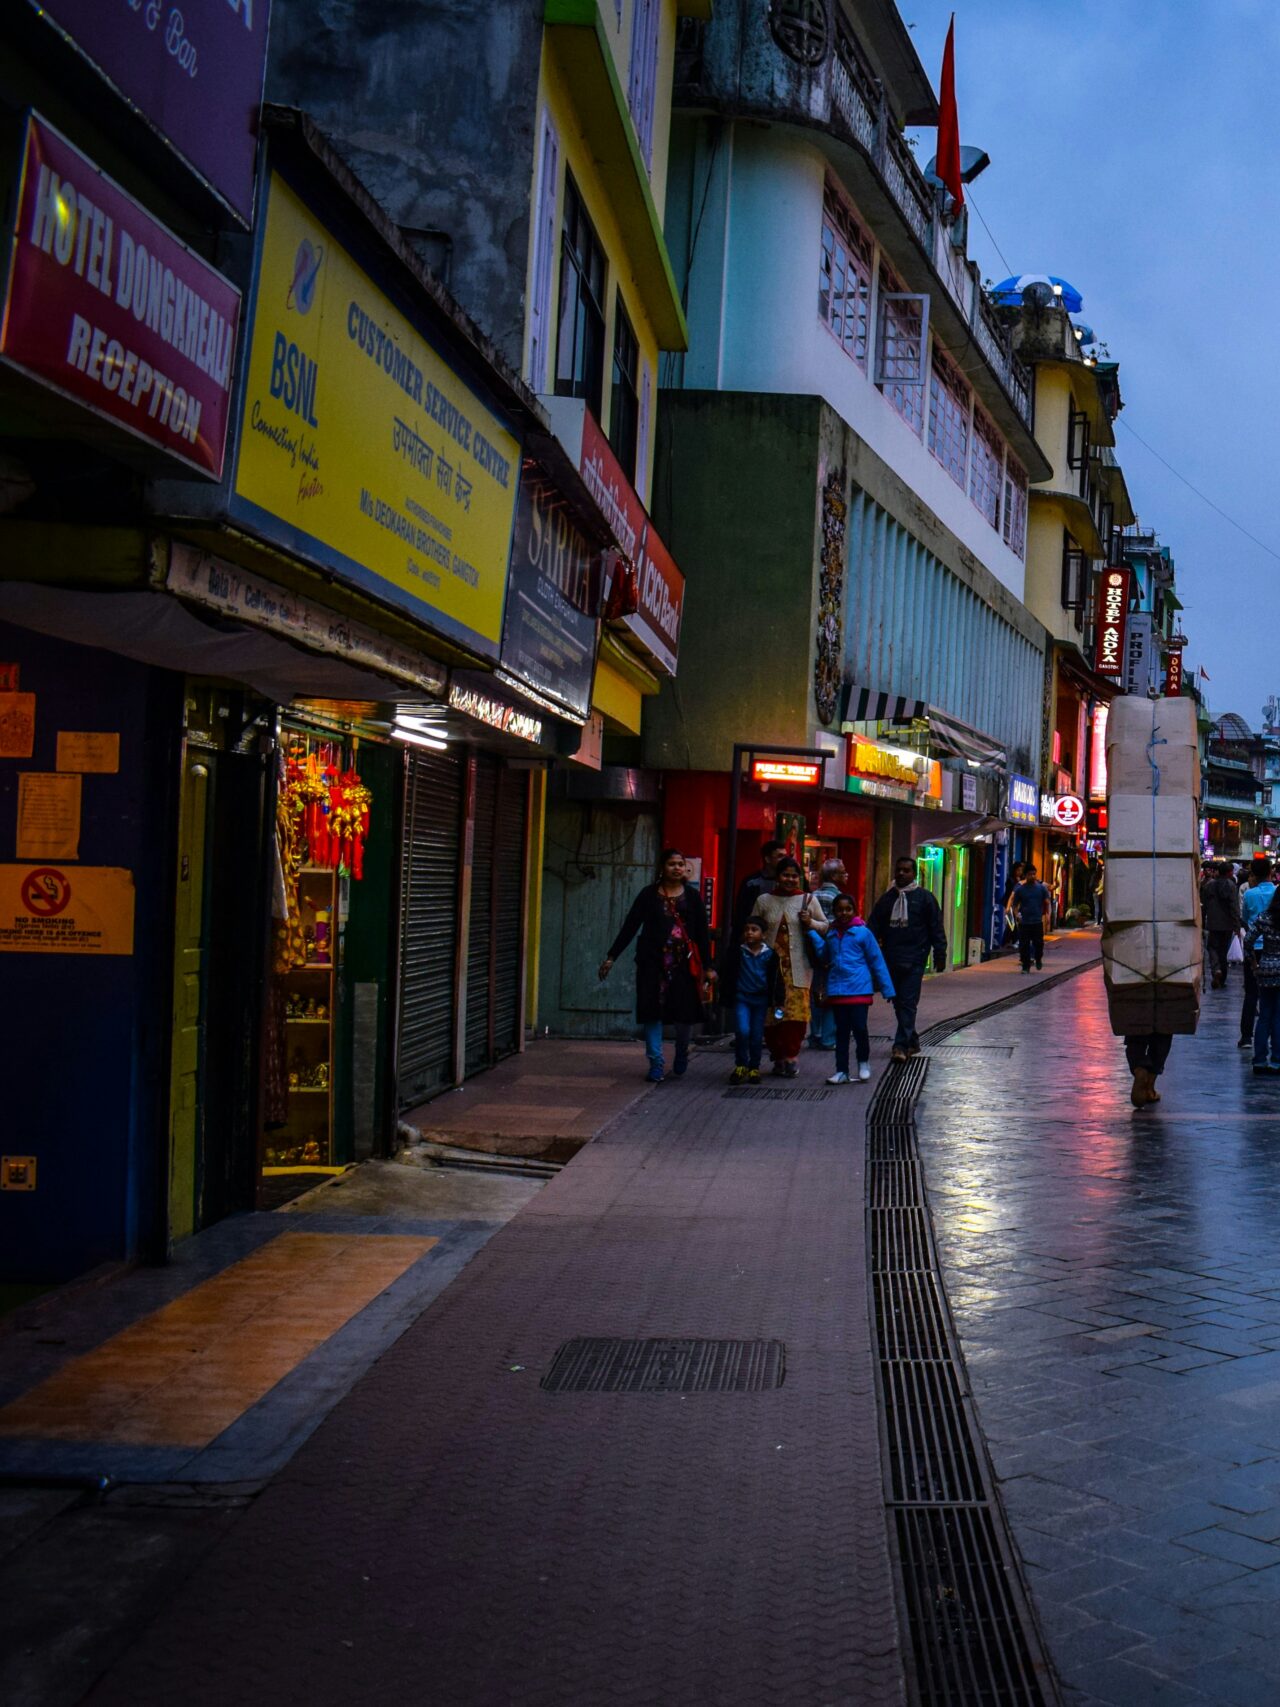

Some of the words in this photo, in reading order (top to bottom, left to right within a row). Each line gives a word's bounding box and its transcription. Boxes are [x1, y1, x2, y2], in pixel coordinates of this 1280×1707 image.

[166, 8, 198, 78] Bar
[31, 162, 112, 297] HOTEL
[115, 229, 233, 392] DONGKHEALA
[67, 313, 202, 444] RECEPTION
[270, 330, 318, 429] BSNL
[347, 300, 424, 406] CUSTOMER
[426, 380, 472, 454] SERVICE
[472, 432, 511, 490] CENTRE
[251, 401, 298, 466] Connecting
[299, 435, 319, 471] India
[436, 446, 453, 499] सेवा
[527, 482, 592, 617] SARITA
[641, 560, 664, 626] ICICI
[662, 587, 679, 643] Bank
[1105, 588, 1123, 624] HOTEL
[1102, 626, 1119, 663] ANOLA
[1128, 632, 1143, 695] PROFILE
[15, 916, 29, 924] NO
[31, 917, 75, 925] SMOKING
